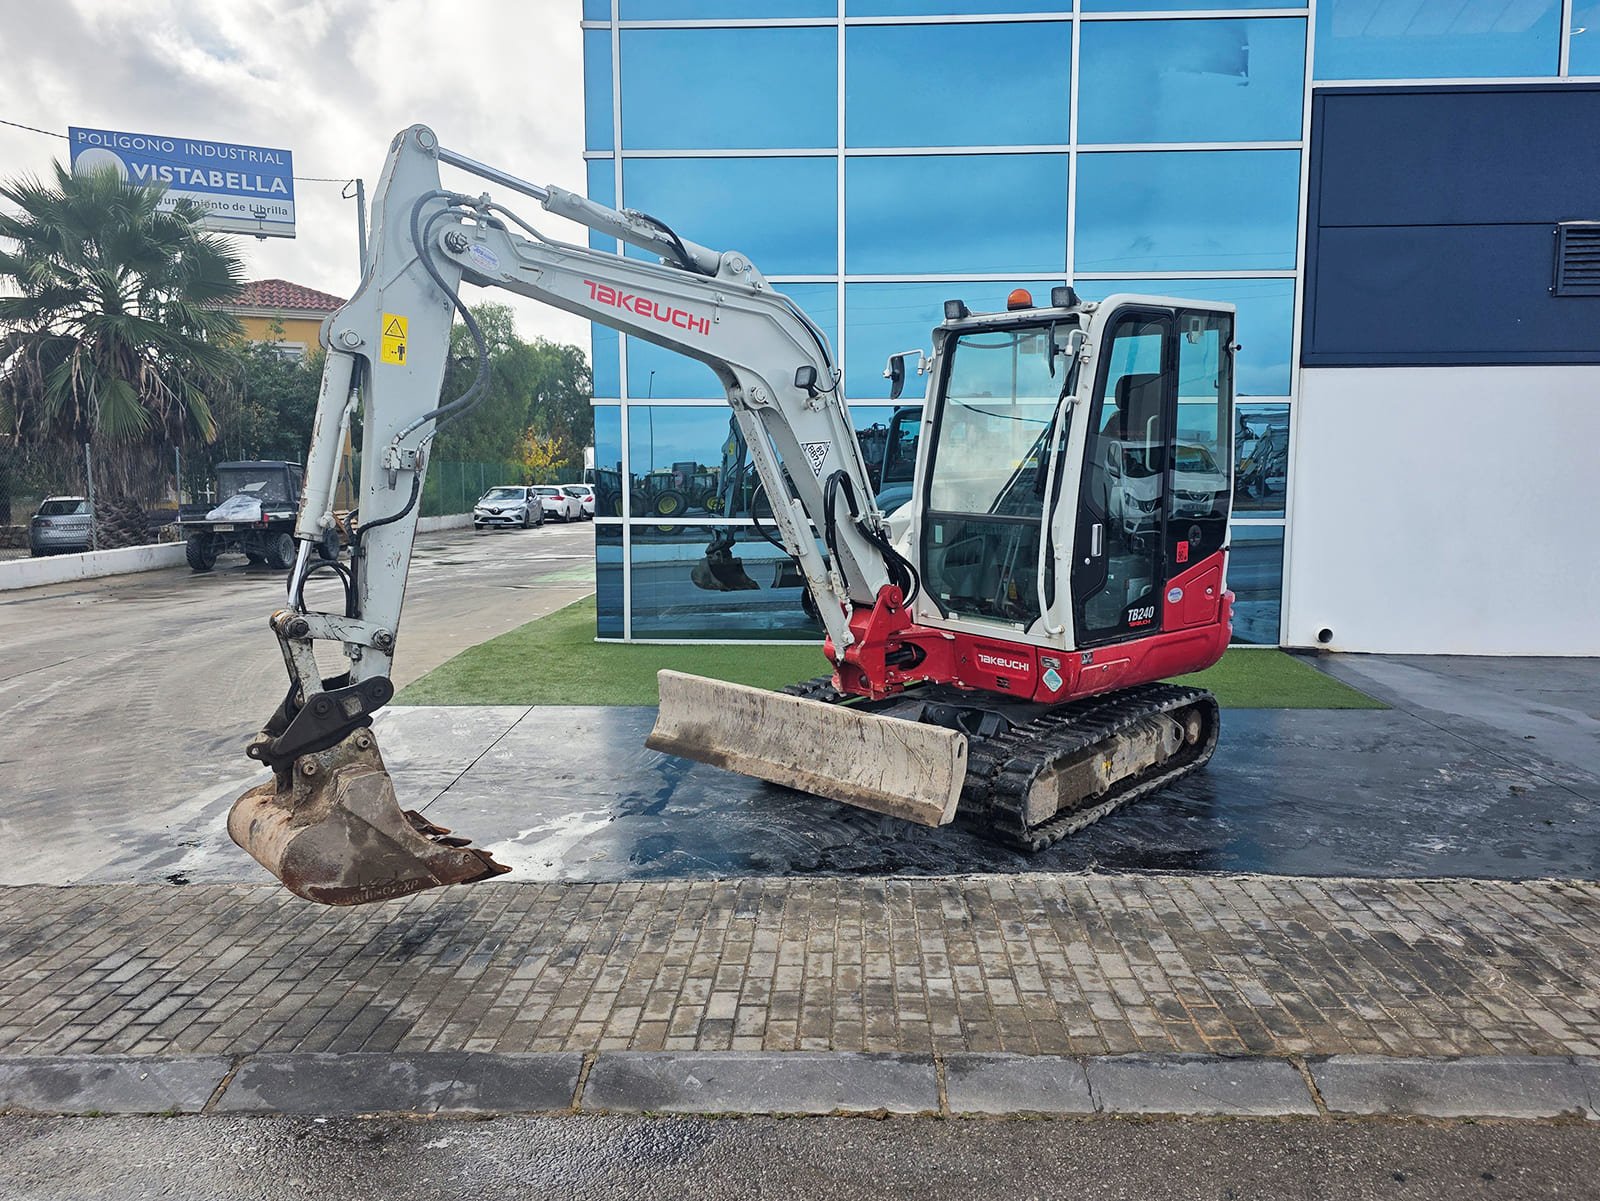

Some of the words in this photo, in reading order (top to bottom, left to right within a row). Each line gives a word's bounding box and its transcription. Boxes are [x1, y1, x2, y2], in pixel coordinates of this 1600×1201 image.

[77, 131, 175, 154] POLÍGONO
[185, 143, 284, 165] INDUSTRIAL
[131, 162, 288, 194] VISTABELLA
[232, 202, 246, 212] de
[249, 203, 288, 216] Librilla
[1127, 605, 1155, 622] TB240
